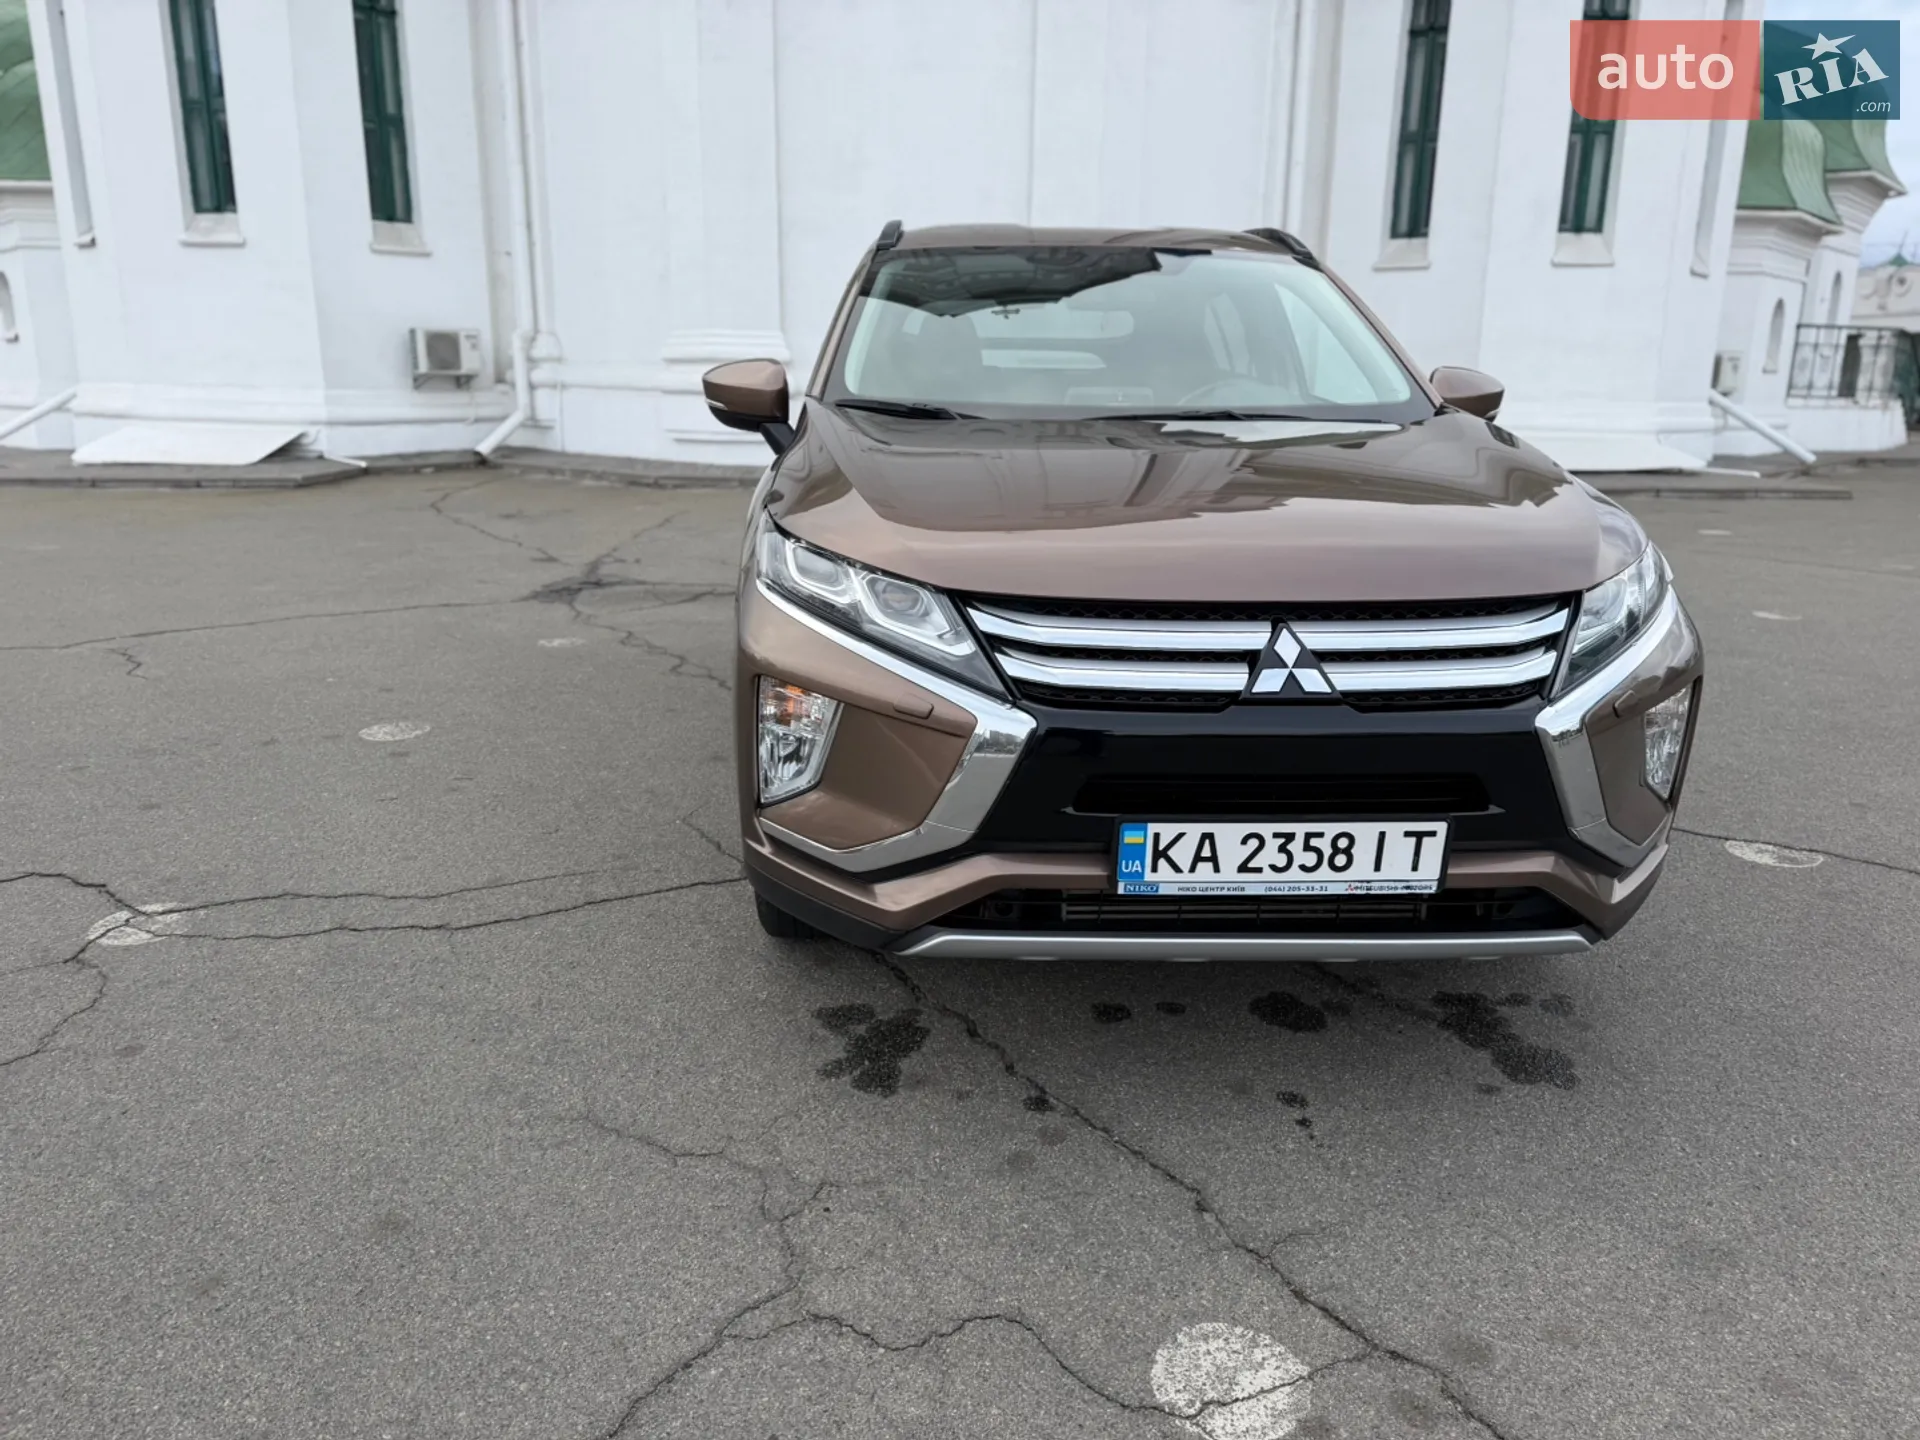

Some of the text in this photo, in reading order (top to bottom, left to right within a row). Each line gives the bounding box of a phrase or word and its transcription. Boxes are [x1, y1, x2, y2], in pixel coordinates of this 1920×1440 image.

[1150, 831, 1221, 875] KA
[1236, 830, 1357, 875] 2358
[1121, 860, 1143, 874] UA
[1124, 884, 1158, 893] NIKO
[1198, 885, 1225, 893] ЦЕНТР
[1226, 885, 1246, 893] КИЇВ
